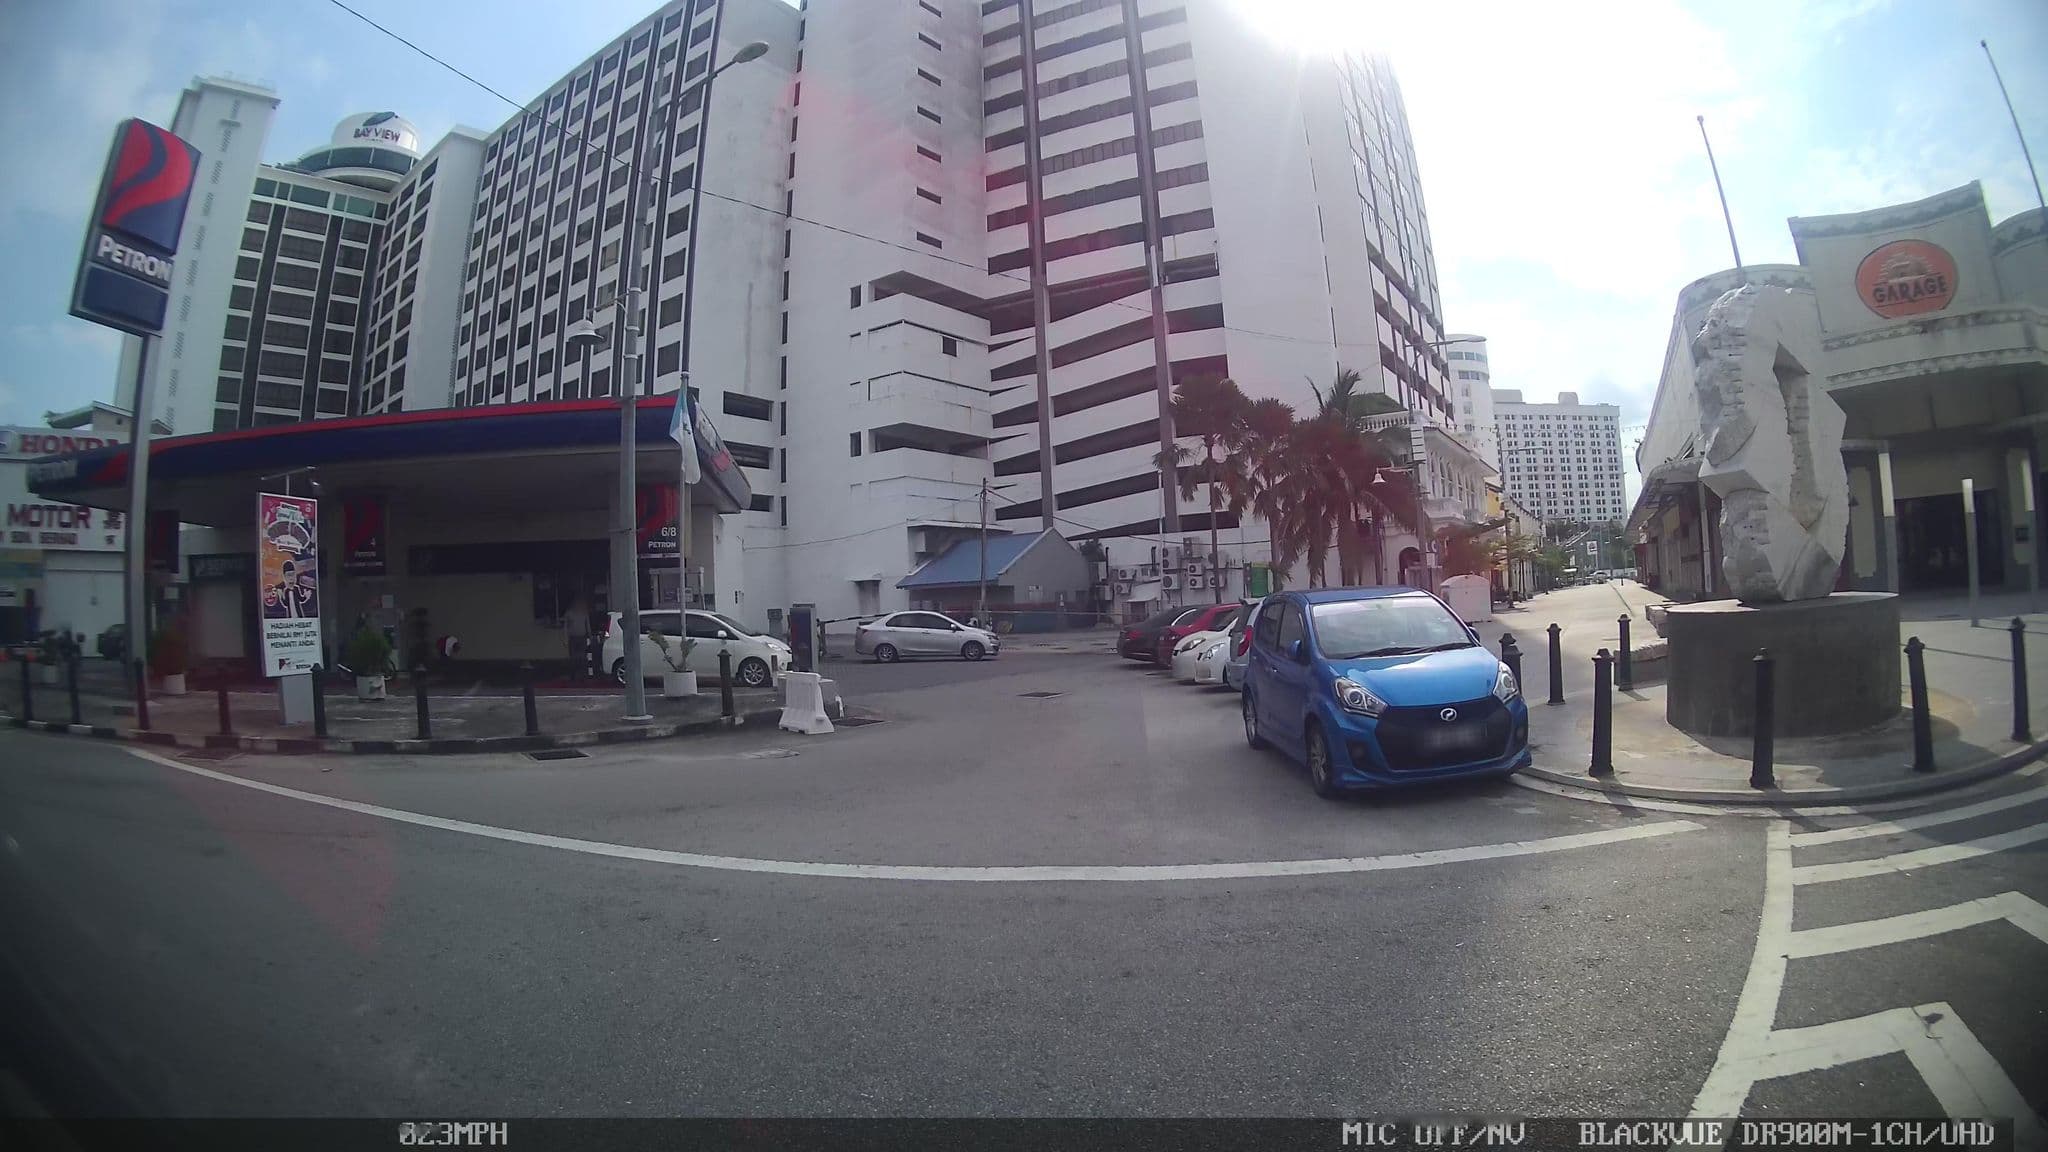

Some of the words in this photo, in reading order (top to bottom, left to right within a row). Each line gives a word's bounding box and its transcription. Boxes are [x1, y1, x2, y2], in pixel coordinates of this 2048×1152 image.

[353, 127, 372, 138] BAY
[374, 128, 400, 142] VIEW
[97, 235, 172, 281] PETRON
[1873, 276, 1947, 303] GARAGE
[8, 504, 90, 528] MOTOR
[661, 527, 677, 537] 6/8
[648, 541, 676, 549] PETRON
